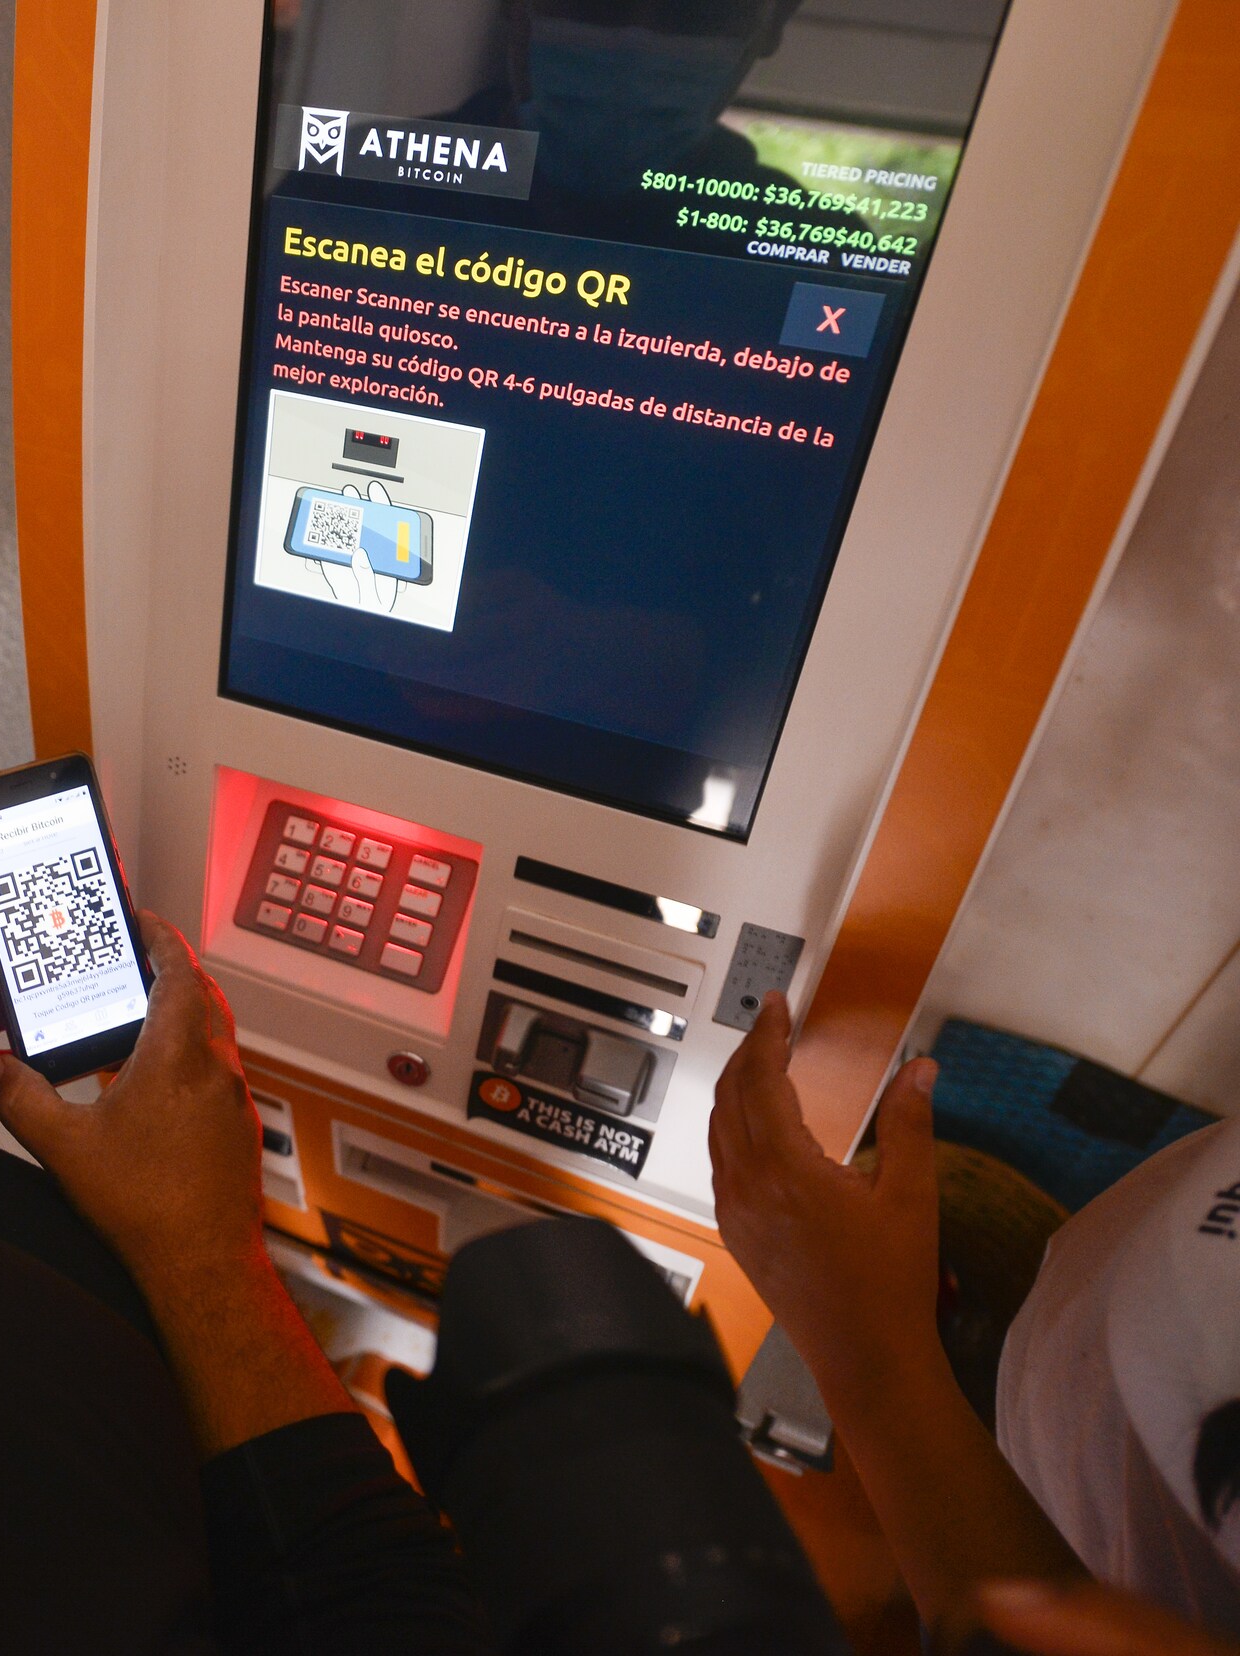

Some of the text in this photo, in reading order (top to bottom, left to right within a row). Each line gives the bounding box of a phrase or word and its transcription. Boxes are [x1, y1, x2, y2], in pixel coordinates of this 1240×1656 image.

[359, 128, 508, 172] ATHENA
[398, 165, 463, 184] BITCOIN
[640, 169, 760, 201] $801-10000:
[801, 162, 938, 191] TIERED PRICING
[676, 206, 749, 234] $1-800:
[284, 227, 631, 308] Escanea el código QR
[746, 240, 912, 275] COMPRAR VENDER
[277, 303, 459, 350] la pantalla quiosco.
[280, 275, 851, 384] Escaner Scanner se encuentra a la izquierda, debajo de
[272, 363, 444, 407] mejor exploración.
[275, 333, 836, 448] Mantenga su código QR 4-6 pulgadas de distancia de la
[31, 815, 64, 832] Bitcoin
[288, 825, 296, 837] 1
[323, 835, 334, 848] 2
[360, 847, 371, 860] 3
[278, 853, 288, 866] 4
[314, 864, 324, 877] 5
[271, 881, 280, 893] 7
[351, 876, 362, 889] 6
[304, 893, 315, 906] 8
[343, 904, 353, 918] 9
[33, 1008, 55, 1020] Toque
[91, 990, 107, 1003] para
[107, 984, 128, 998] copiar
[517, 1109, 640, 1165] A CASH ATM
[527, 1097, 644, 1150] THIS IS NOT
